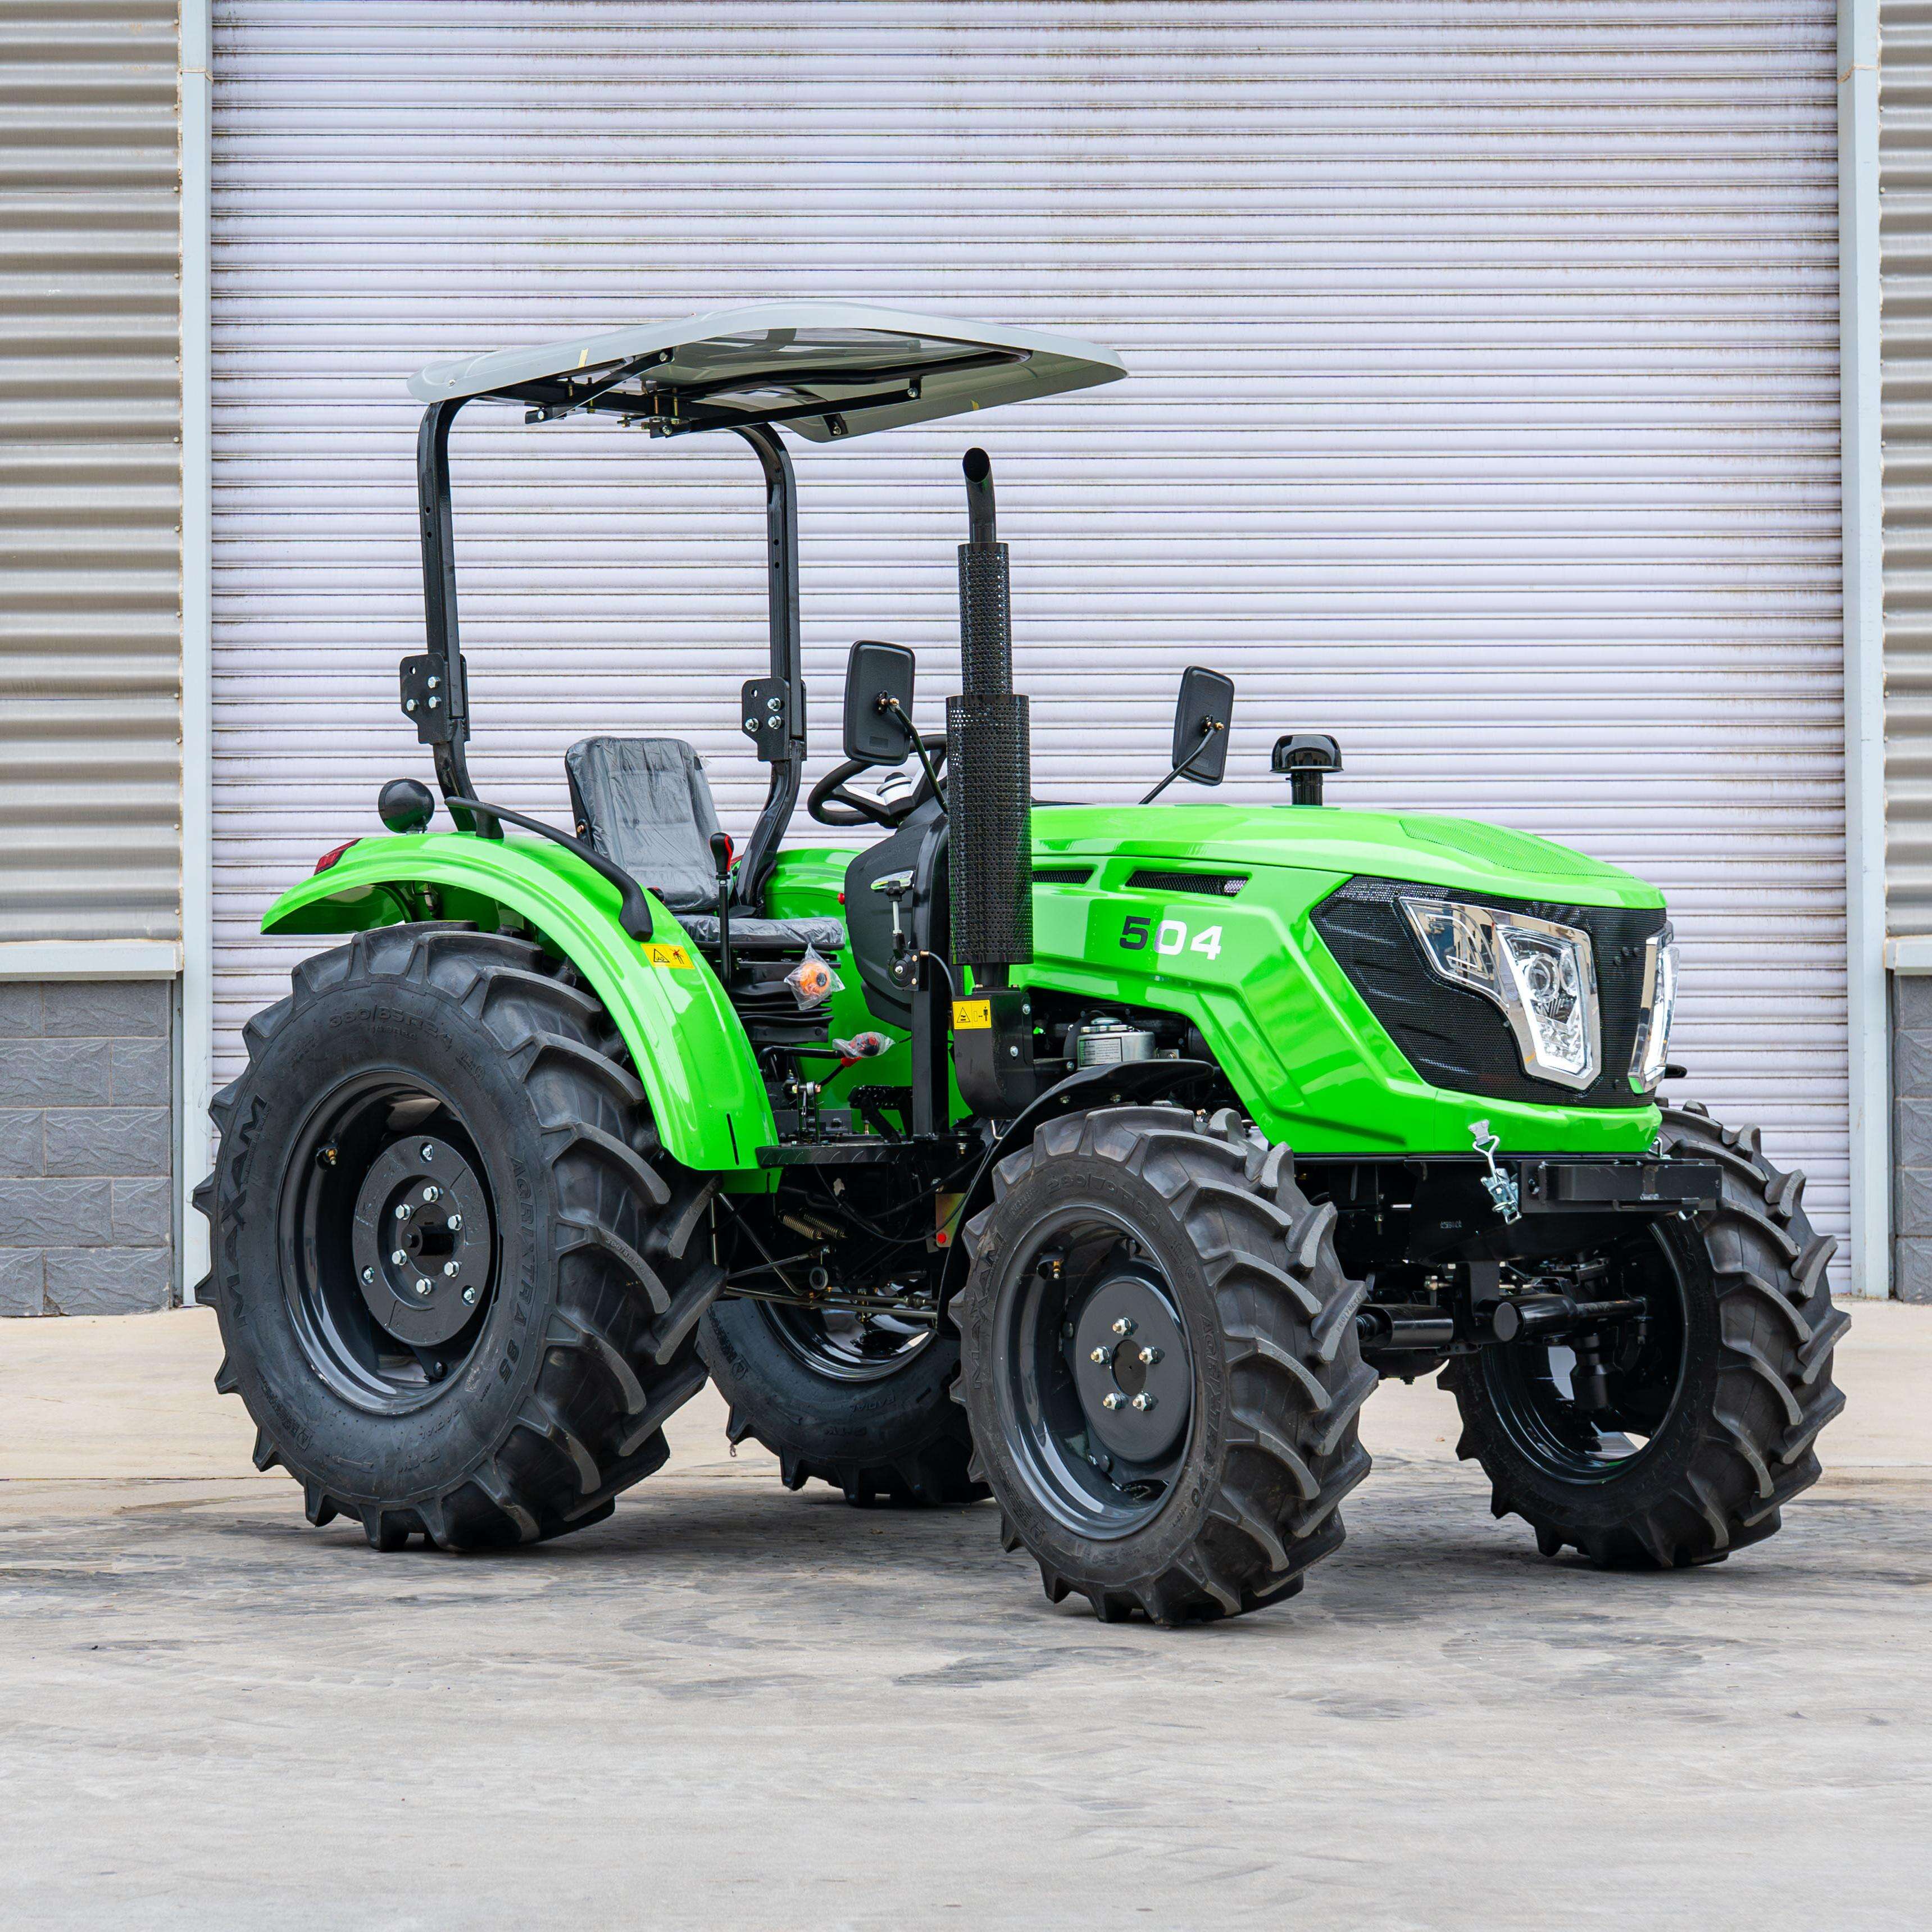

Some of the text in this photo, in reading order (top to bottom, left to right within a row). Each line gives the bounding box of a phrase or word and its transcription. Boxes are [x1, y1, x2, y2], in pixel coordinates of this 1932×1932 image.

[1120, 915, 1222, 960] 504
[220, 1093, 267, 1329] MAXAM
[499, 1155, 535, 1384] AGRIXTRA 85
